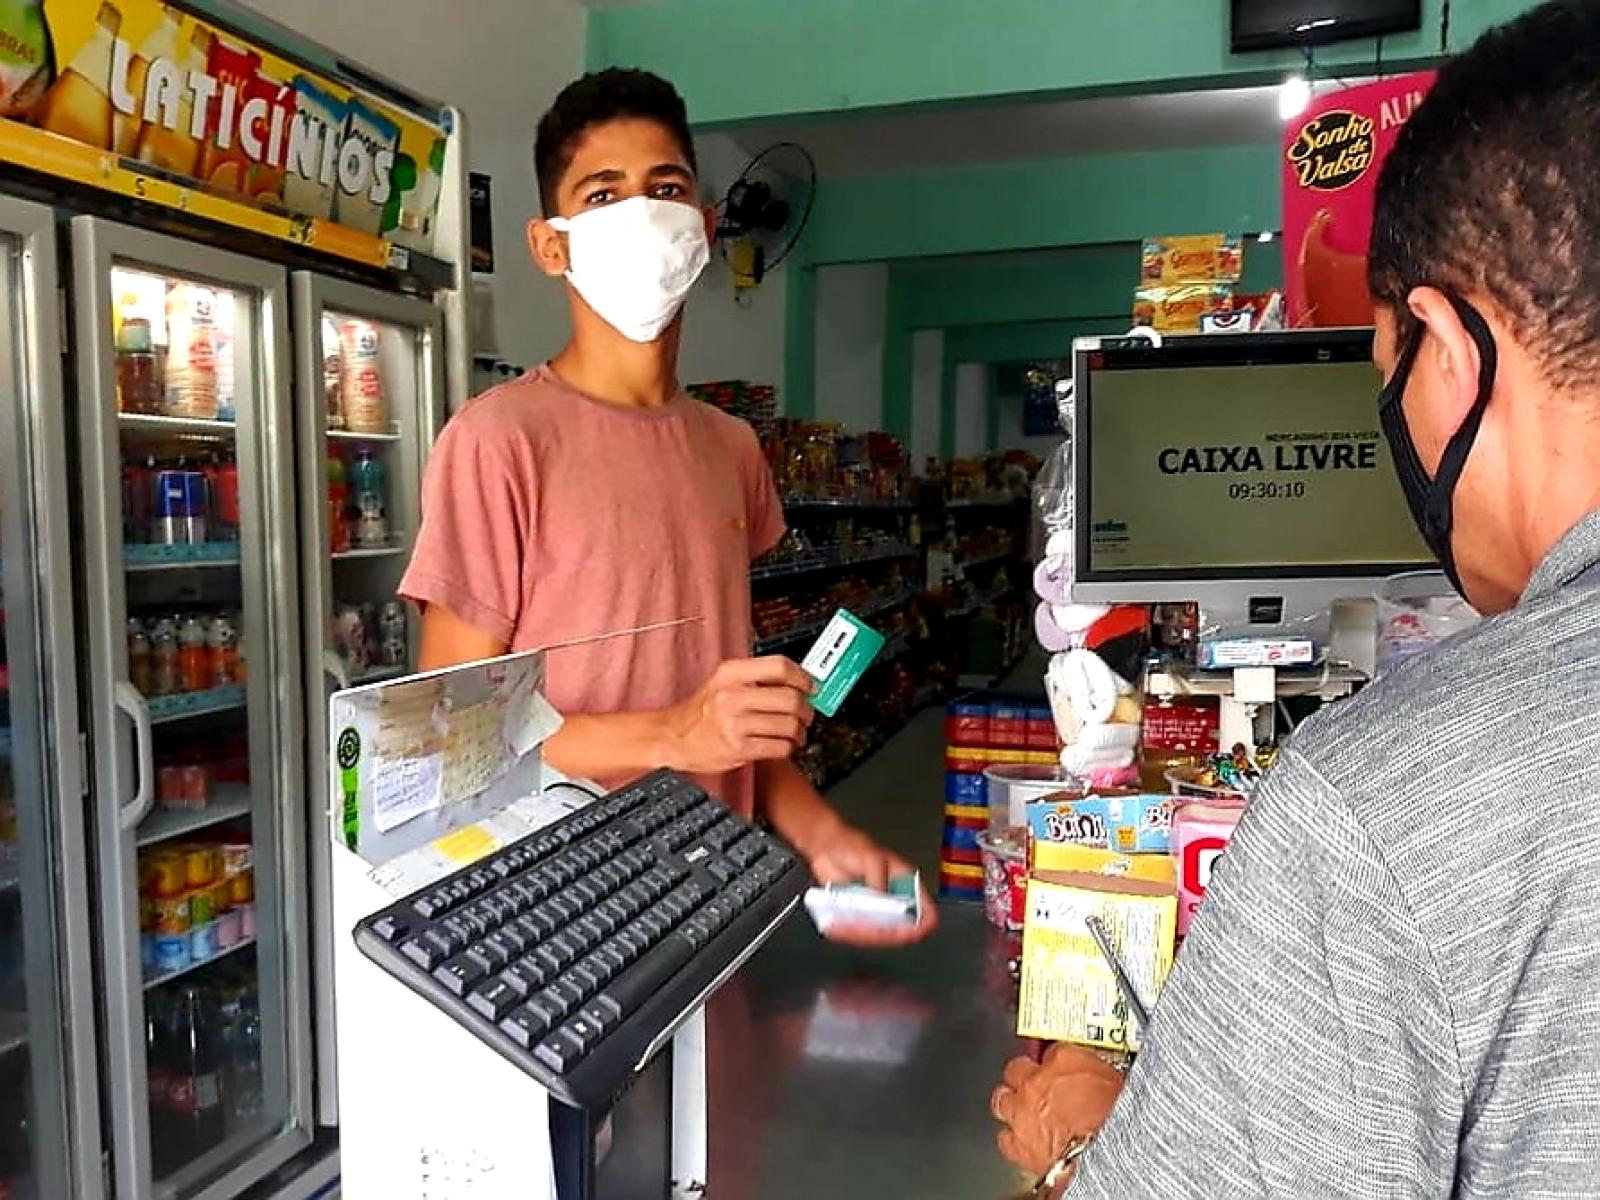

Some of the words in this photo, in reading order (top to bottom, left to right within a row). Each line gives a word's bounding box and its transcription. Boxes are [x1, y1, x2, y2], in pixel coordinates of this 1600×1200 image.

[110, 38, 395, 204] LATICÍNIOS
[1288, 113, 1373, 162] Sonho
[1349, 138, 1368, 154] de
[1298, 151, 1369, 187] Valsa
[1157, 446, 1264, 475] CAIXA
[1275, 443, 1377, 471] LIVRE
[1228, 481, 1305, 499] 09:30:10
